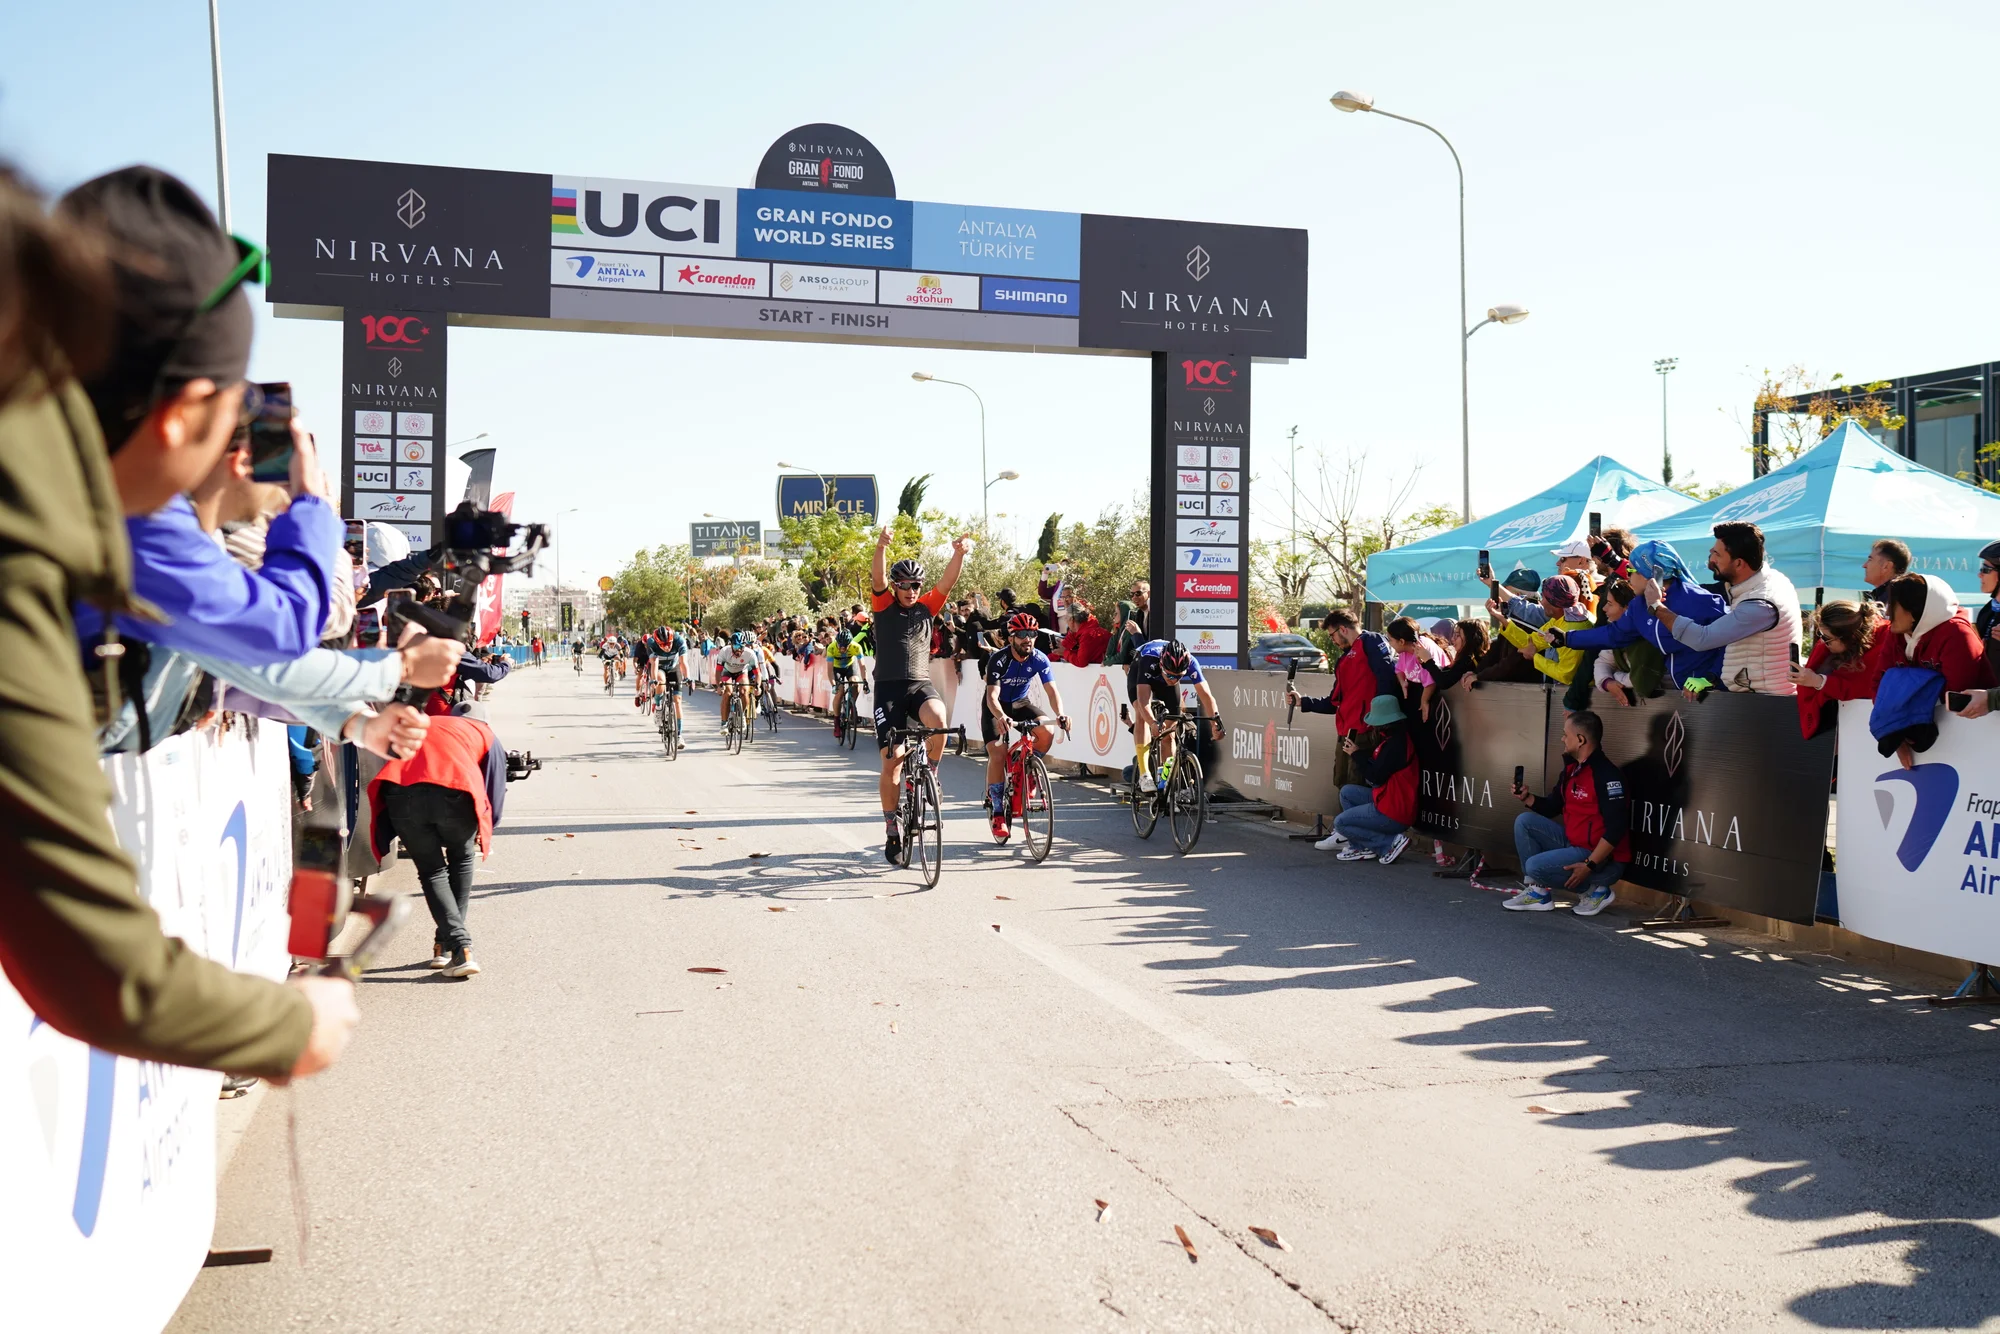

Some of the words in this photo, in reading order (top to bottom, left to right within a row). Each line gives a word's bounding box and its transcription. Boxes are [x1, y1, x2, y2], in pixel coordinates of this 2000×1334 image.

[799, 143, 864, 157] NIRVANA
[788, 160, 819, 176] GRAN
[833, 165, 864, 180] FONDO
[585, 190, 720, 244] UCI
[756, 207, 815, 224] GRAN
[821, 211, 893, 229] FONDO
[957, 220, 1037, 239] ANTALYA
[754, 227, 826, 246] WORLD
[830, 233, 895, 250] SERIES
[315, 238, 504, 270] NIRVANA
[959, 239, 1035, 261] TÜRKİYE
[370, 272, 451, 287] HOTELS
[597, 267, 646, 278] ANTALYA
[597, 275, 625, 284] Airport
[697, 274, 756, 286] corendon
[799, 275, 829, 284] ARSO
[831, 277, 869, 286] GROUP
[906, 293, 953, 304] agtohum
[994, 289, 1068, 304] SHIMANO
[1120, 290, 1274, 318] NIRVANA
[758, 308, 814, 324] START
[831, 312, 889, 328] FINISH
[1164, 320, 1231, 334] HOTELS
[351, 383, 438, 398] NIRVANA
[1174, 421, 1244, 434] NIRVANA
[357, 441, 385, 455] TGA
[363, 472, 388, 482] UCI
[1178, 472, 1201, 485] TGA
[370, 502, 416, 519] Türkiye
[793, 500, 864, 514] MIRCLE
[1184, 500, 1204, 510] UCI
[695, 525, 755, 537] TITANIC
[1189, 527, 1227, 542] Türkiye
[1910, 556, 1969, 571] RVANA
[1397, 572, 1442, 584] NIRVANA
[1447, 572, 1478, 581] HOTEL
[1195, 583, 1232, 592] corendon
[1243, 688, 1294, 709] NIRVA
[875, 707, 887, 726] CPA
[1232, 727, 1262, 760] GRAN
[1277, 735, 1309, 770] FONDO
[1244, 774, 1261, 786] ANTALYA
[1422, 769, 1493, 808] RVANA
[1421, 810, 1460, 830] HOTELS
[1630, 800, 1742, 852] IRVANA
[1635, 851, 1689, 877] HOTELS
